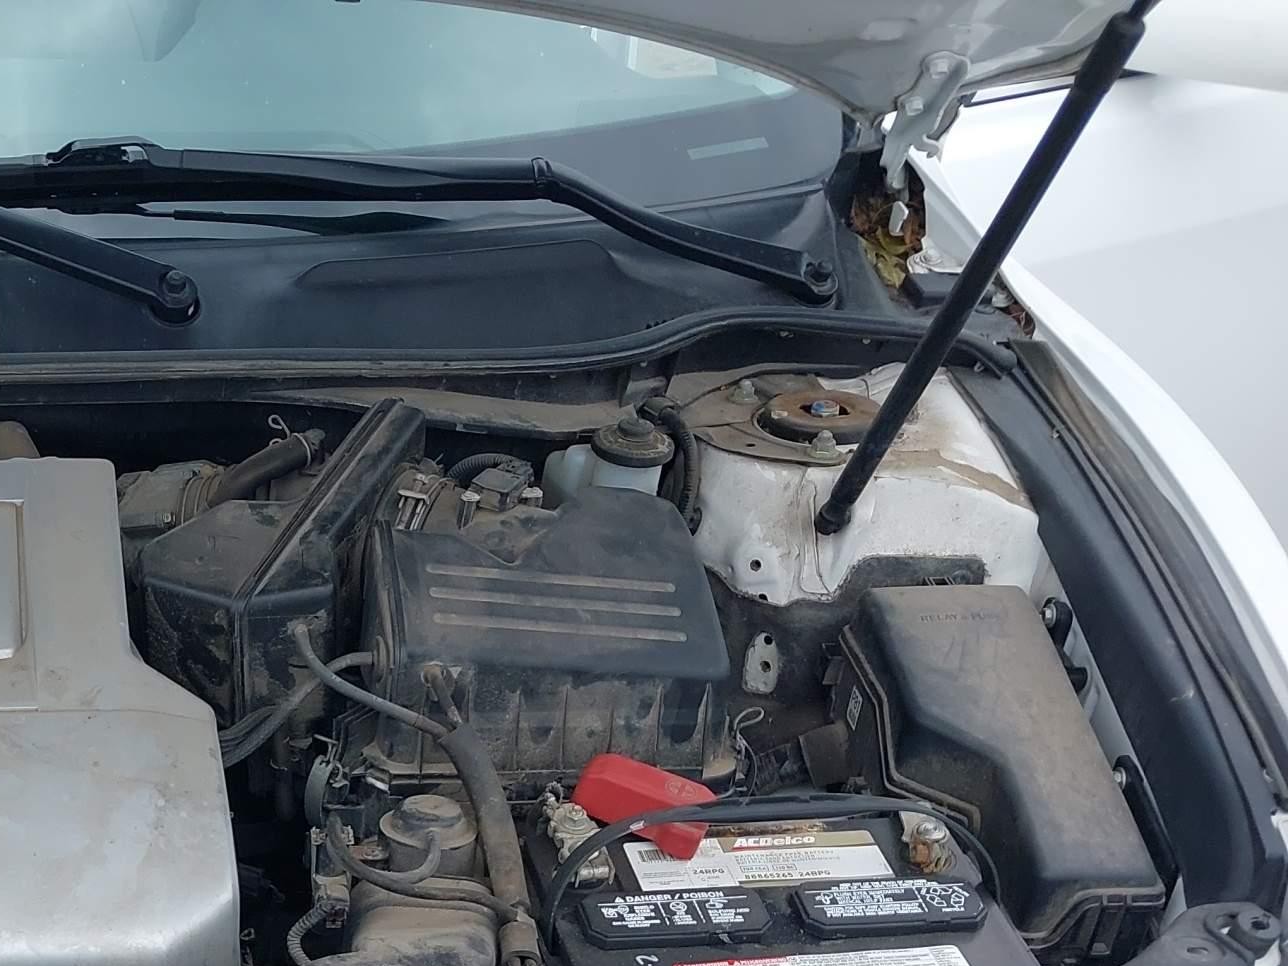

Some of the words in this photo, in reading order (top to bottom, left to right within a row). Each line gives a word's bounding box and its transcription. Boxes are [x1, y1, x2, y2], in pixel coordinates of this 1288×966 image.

[733, 835, 816, 848] ACDelco
[625, 894, 672, 903] DANGER
[682, 890, 725, 899] POISON
